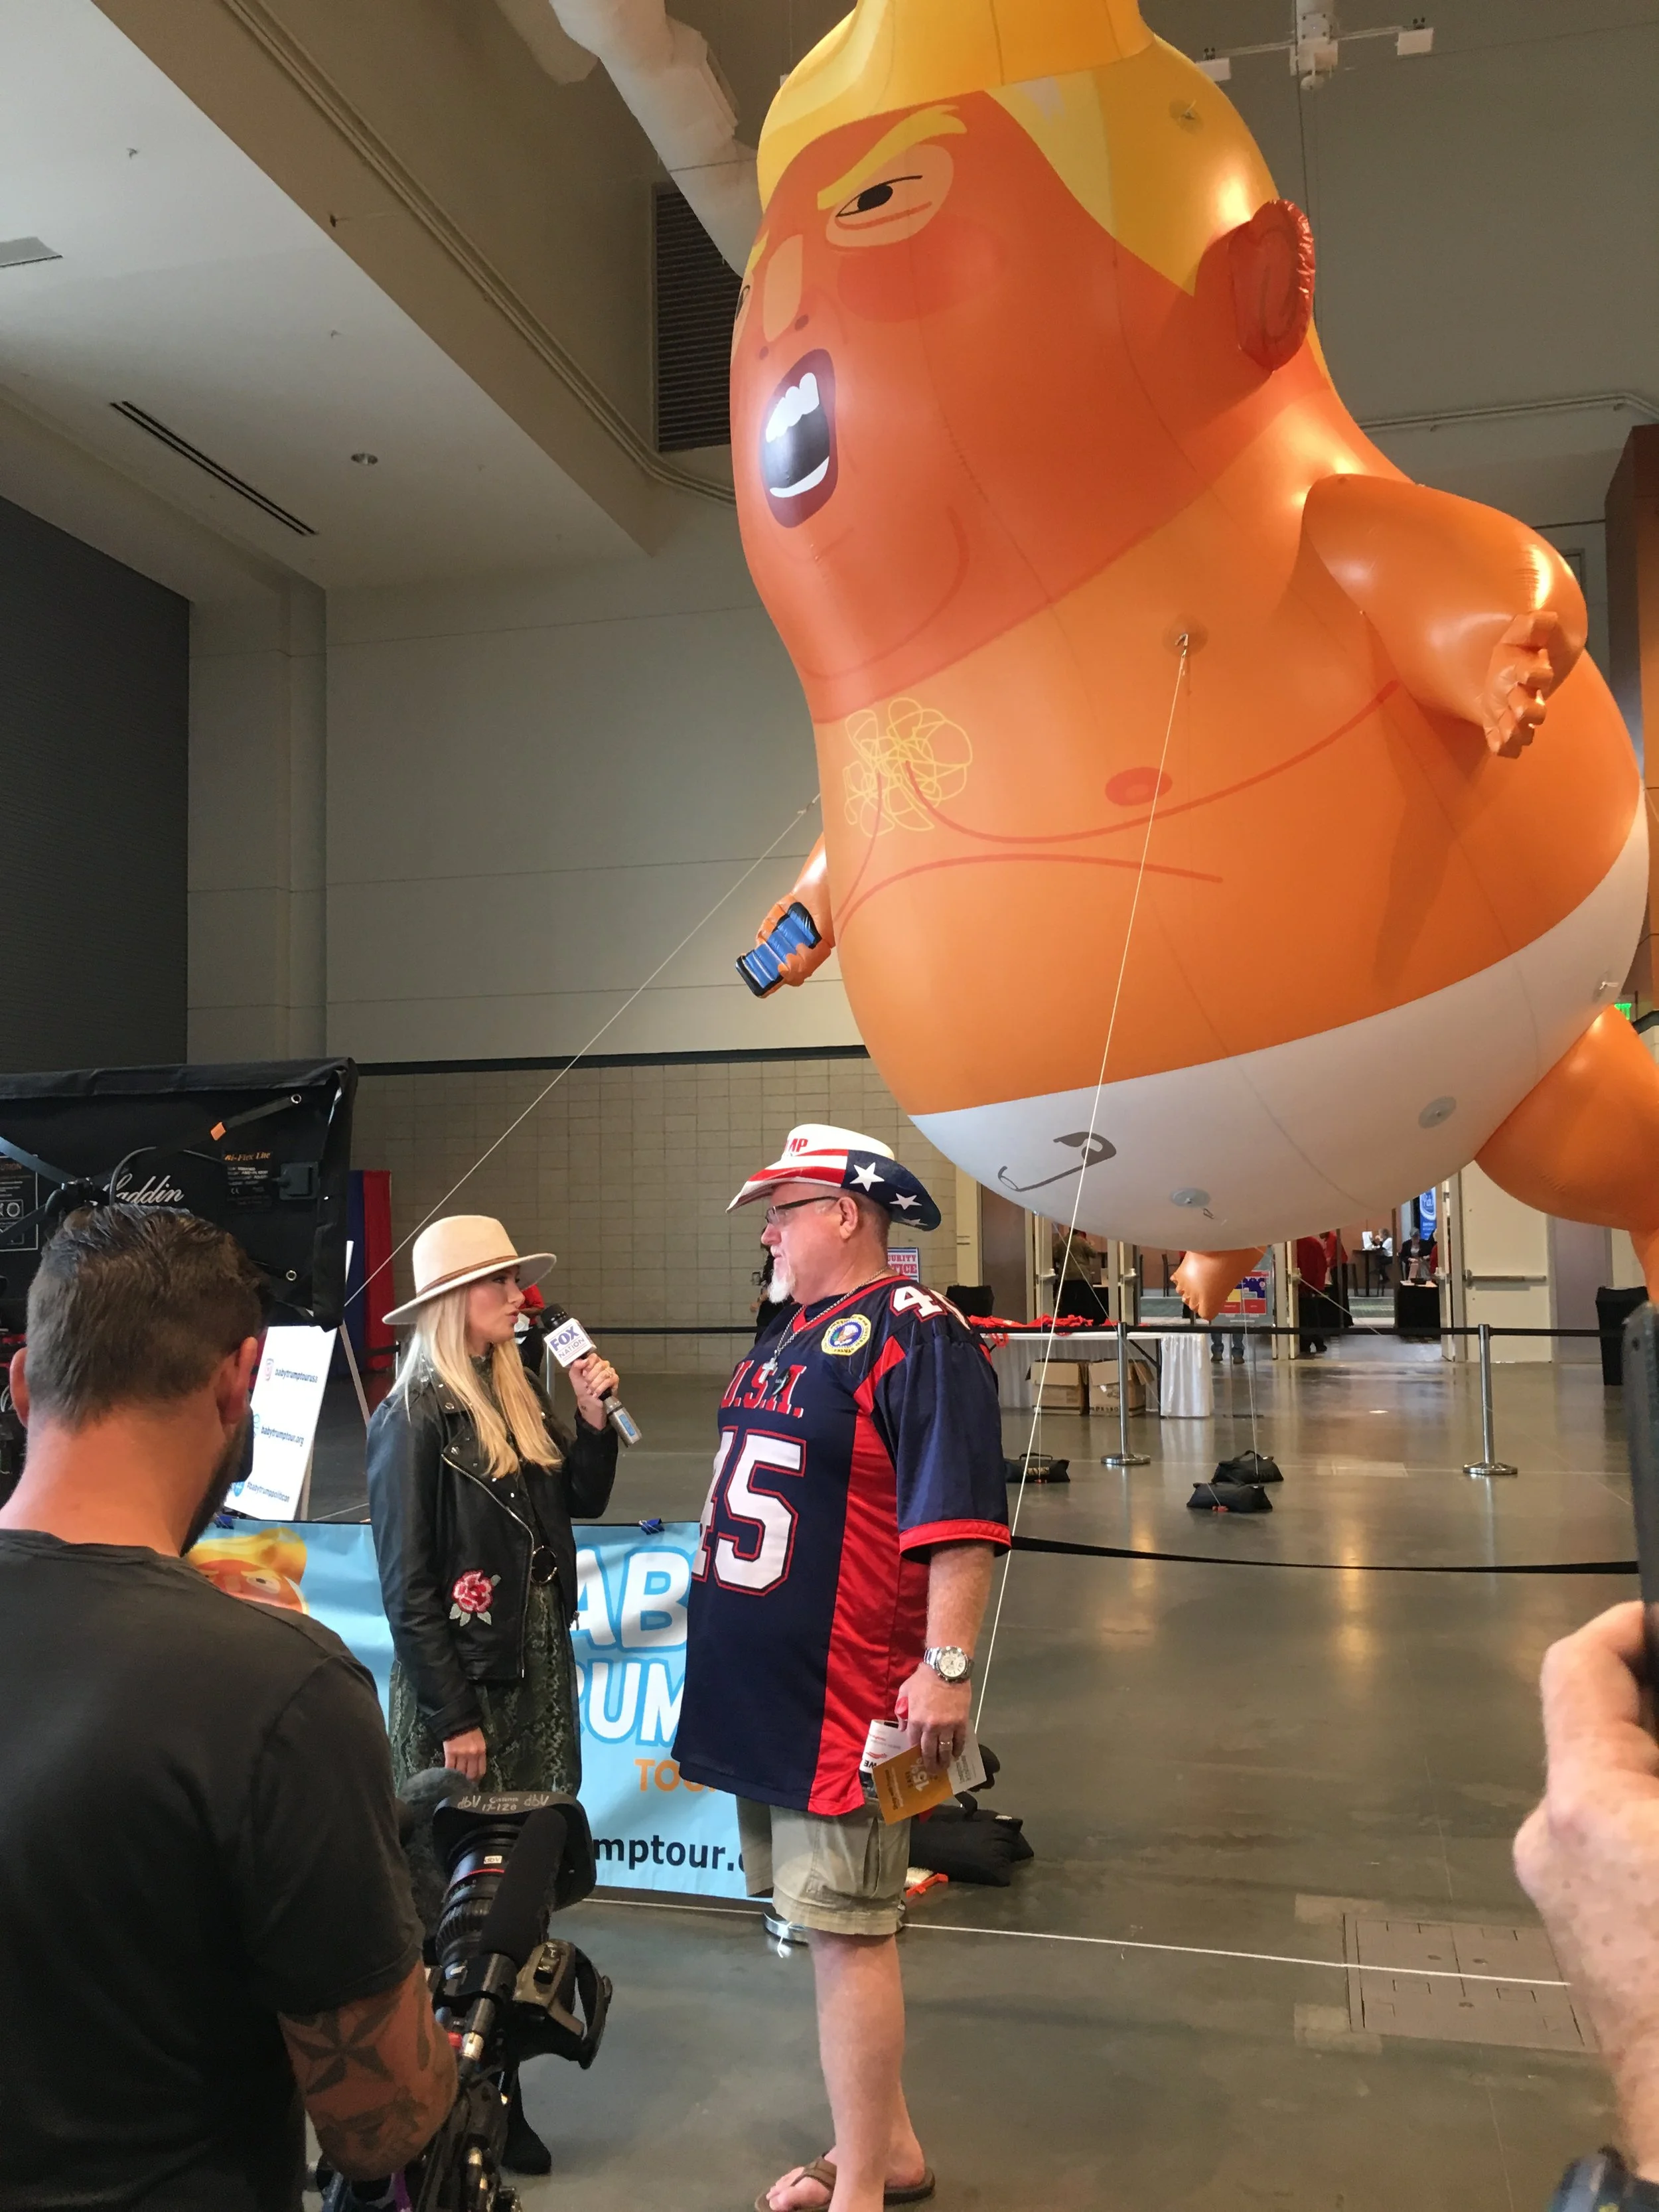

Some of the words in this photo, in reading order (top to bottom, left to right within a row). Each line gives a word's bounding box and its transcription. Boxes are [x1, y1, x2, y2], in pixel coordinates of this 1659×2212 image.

[786, 1138, 809, 1153] MP
[549, 1325, 580, 1352] FOX
[558, 1337, 585, 1359] NATION
[261, 1426, 304, 1447] babytrumptour.org
[577, 1661, 685, 1743] UM
[634, 1758, 716, 1792] TO
